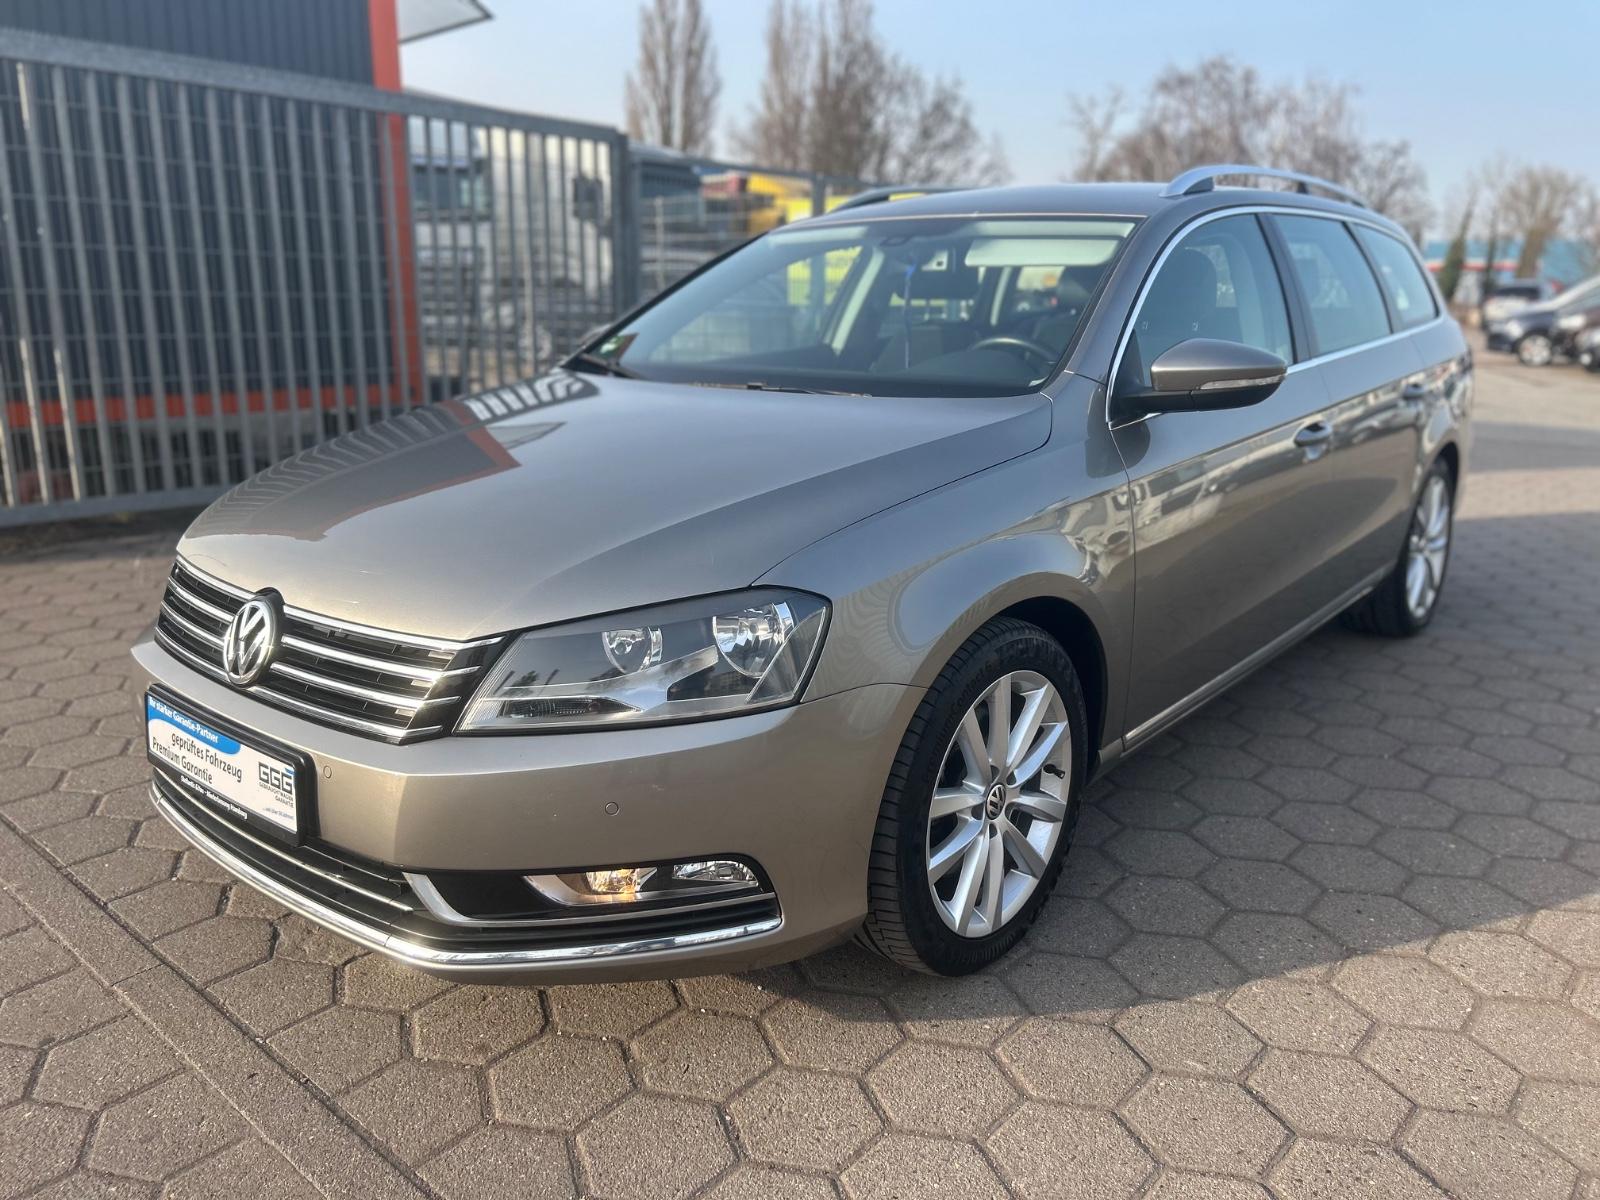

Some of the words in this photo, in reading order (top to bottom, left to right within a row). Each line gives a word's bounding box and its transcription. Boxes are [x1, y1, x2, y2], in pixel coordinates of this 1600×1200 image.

[172, 710, 218, 744] Garantie-Partner
[152, 736, 180, 766] Premium
[181, 755, 213, 784] Garantie
[171, 732, 204, 760] geprüftes
[205, 748, 242, 783] Fahrzeug
[258, 761, 293, 795] GGG
